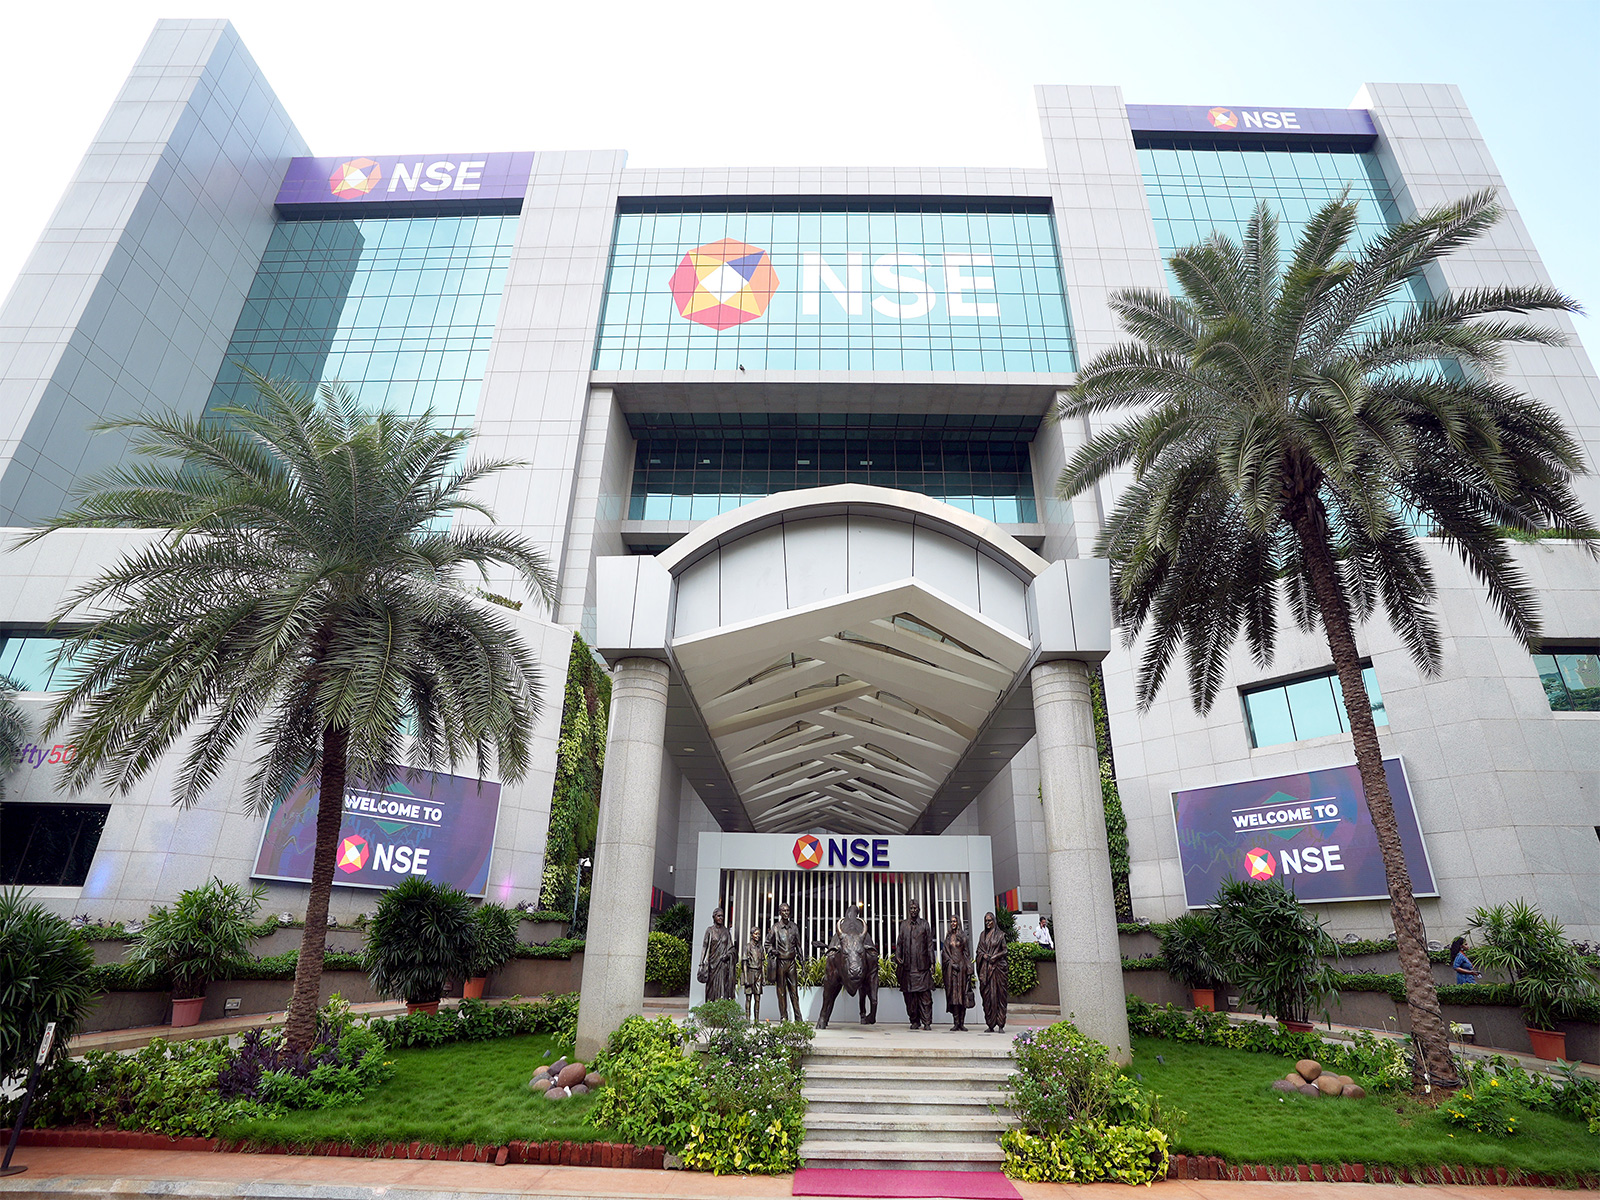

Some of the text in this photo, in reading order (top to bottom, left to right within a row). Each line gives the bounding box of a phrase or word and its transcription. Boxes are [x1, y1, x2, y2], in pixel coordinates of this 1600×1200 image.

[1241, 110, 1301, 130] NSE
[386, 160, 486, 193] NSE
[801, 250, 1001, 320] NSE
[344, 794, 443, 822] WELCOME TO
[1232, 803, 1339, 828] WELCOME TO
[372, 843, 431, 876] NSE
[828, 838, 890, 868] NSE
[1279, 844, 1346, 875] NSE
